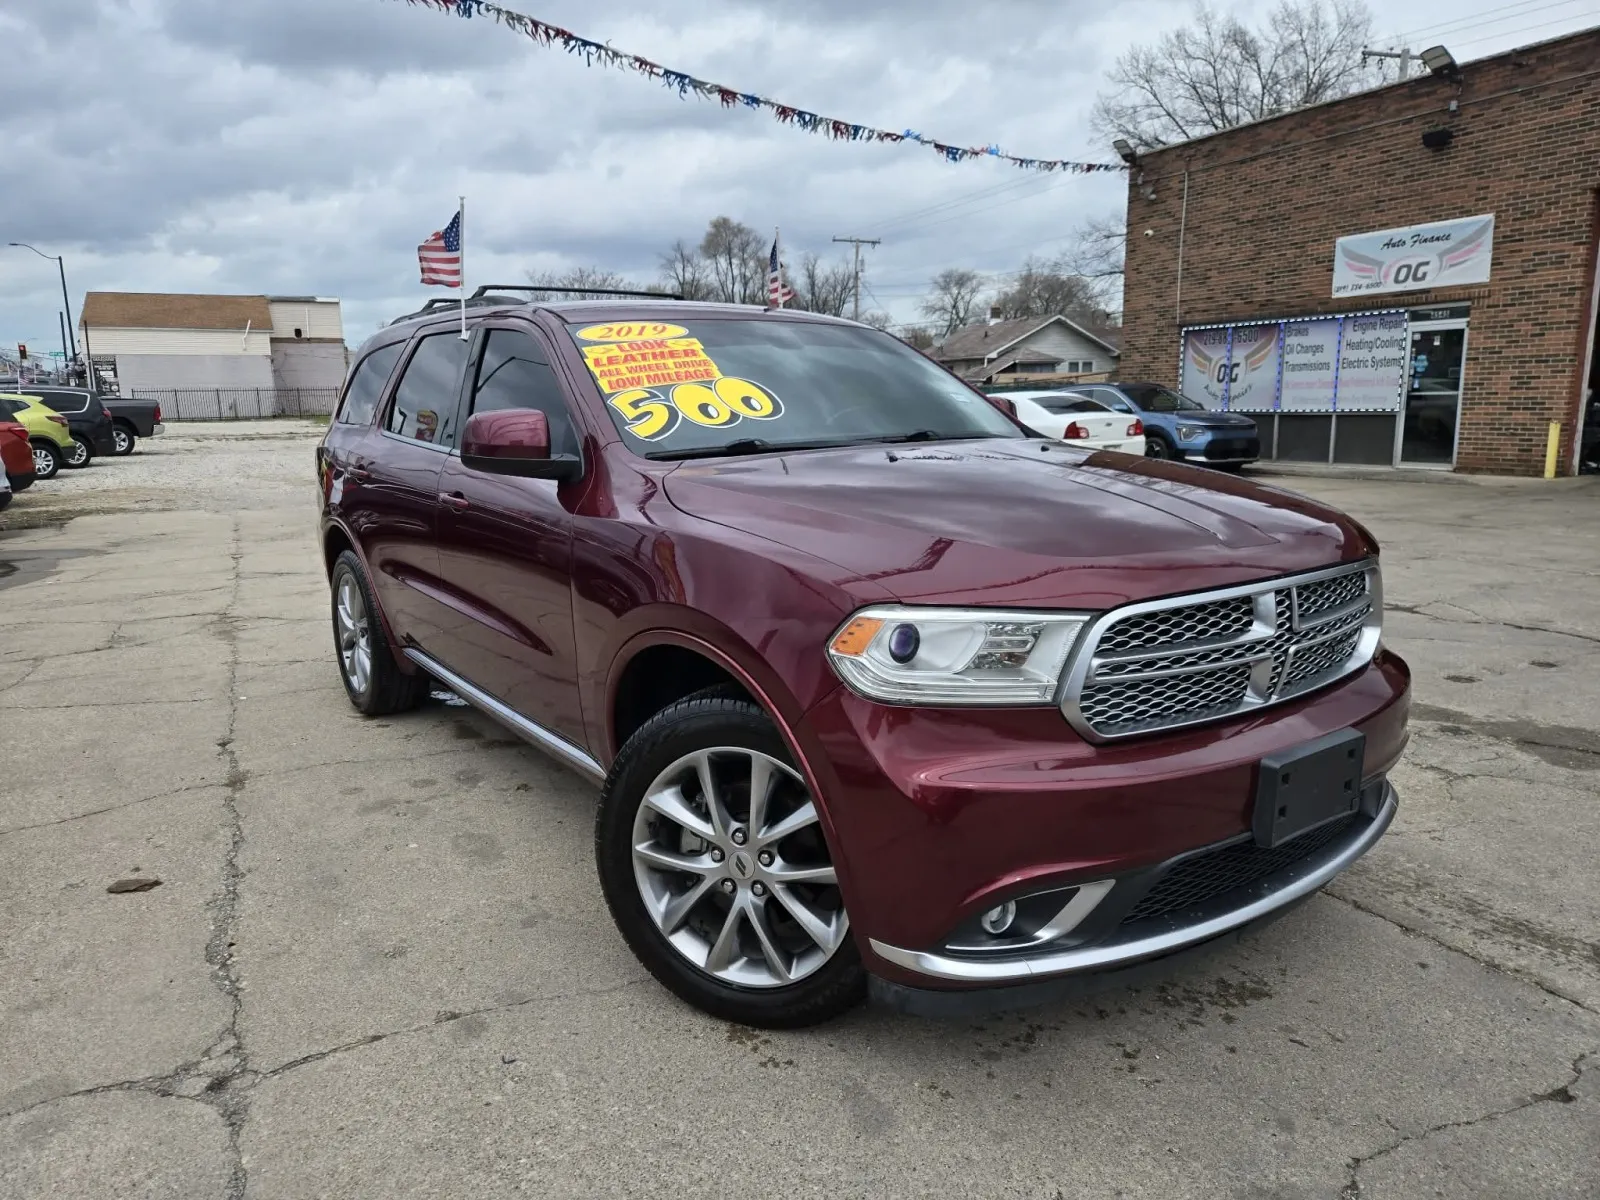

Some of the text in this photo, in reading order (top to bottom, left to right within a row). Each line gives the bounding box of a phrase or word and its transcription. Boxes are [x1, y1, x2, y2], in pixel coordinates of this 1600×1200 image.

[1380, 233, 1451, 250] Auto Finance
[1393, 260, 1430, 284] OG
[598, 325, 668, 339] 2019
[1287, 326, 1309, 337] Brakes
[1353, 320, 1377, 334] Engine
[616, 340, 669, 353] LOOK
[1286, 343, 1324, 356] Oil Changes
[593, 348, 698, 368] LEATHER
[1342, 356, 1401, 371] Electric Systems
[599, 358, 711, 379] ALL WHEEL DRIVE
[1285, 360, 1331, 372] Transmissions
[607, 368, 717, 391] LOW MILEAGE
[608, 376, 784, 442] 500
